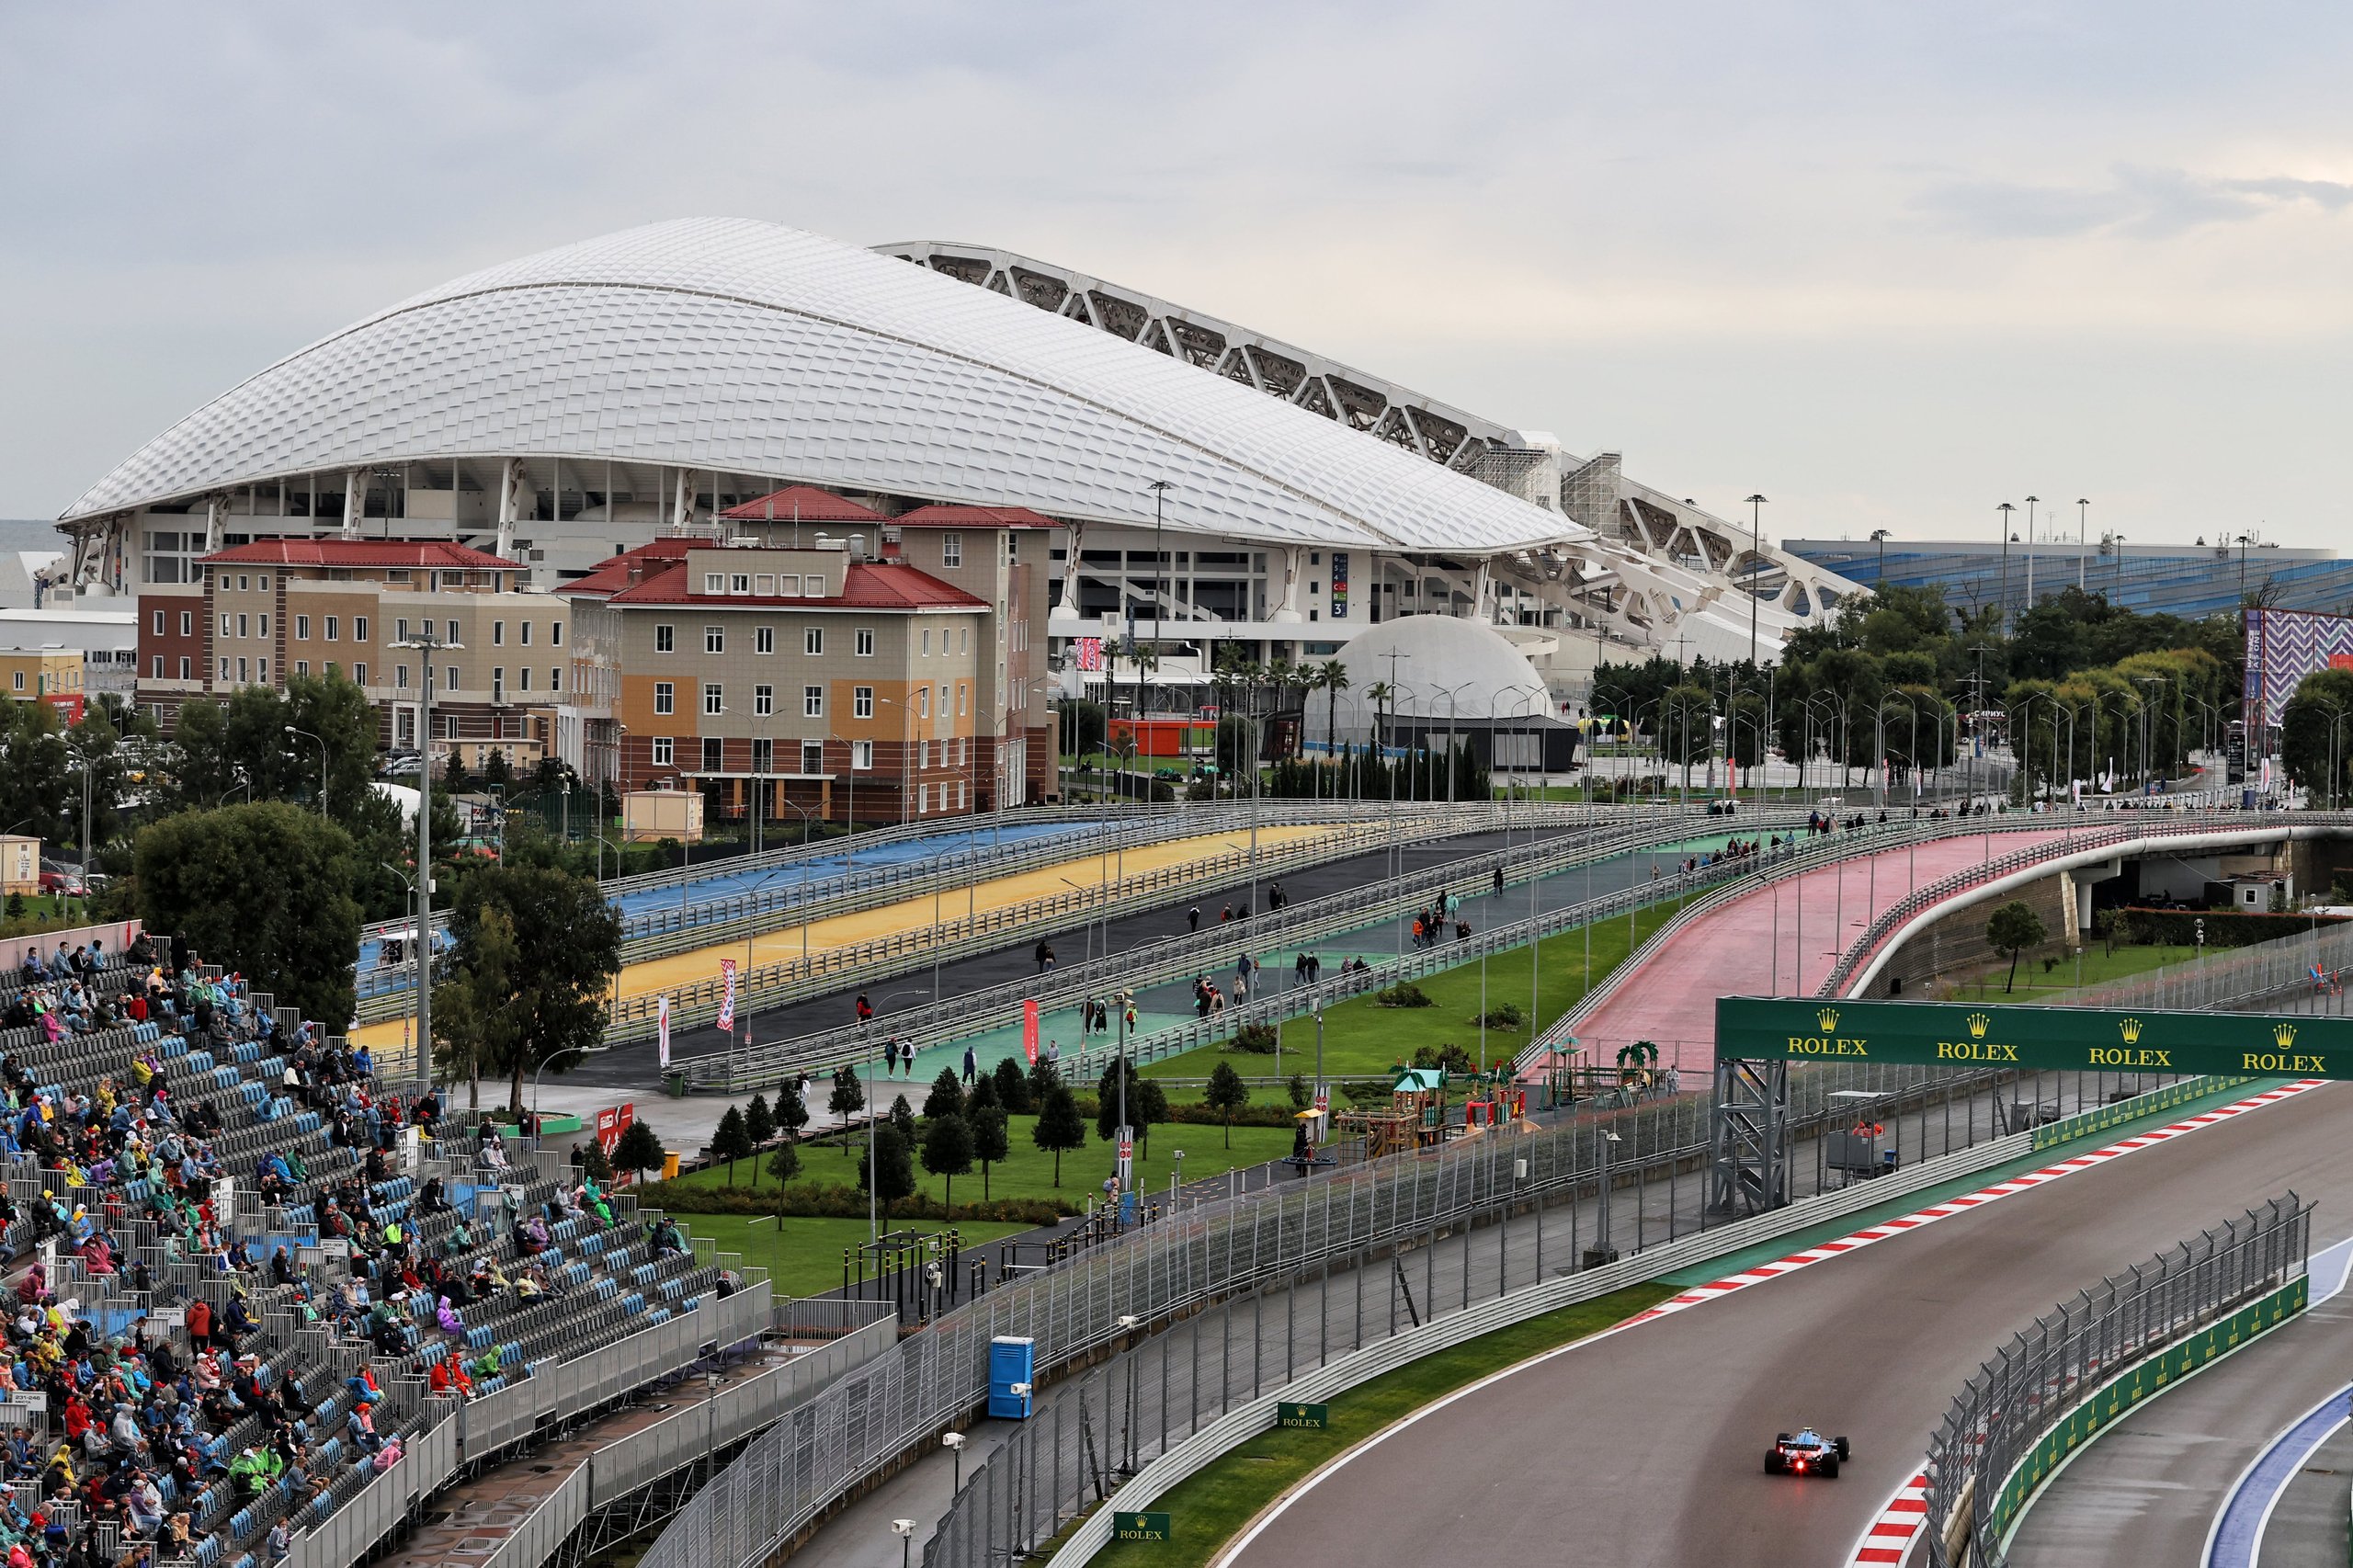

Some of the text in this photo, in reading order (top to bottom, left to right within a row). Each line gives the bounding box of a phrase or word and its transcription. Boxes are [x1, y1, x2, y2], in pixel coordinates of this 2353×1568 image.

[1335, 603, 1342, 615] 3
[1787, 1038, 1869, 1056] ROLEX
[1937, 1042, 2018, 1062] ROLEX
[2088, 1048, 2172, 1067] ROLEX
[2242, 1053, 2326, 1073] ROLEX
[1283, 1418, 1321, 1427] ROLEX
[1120, 1529, 1163, 1540] ROLEX
